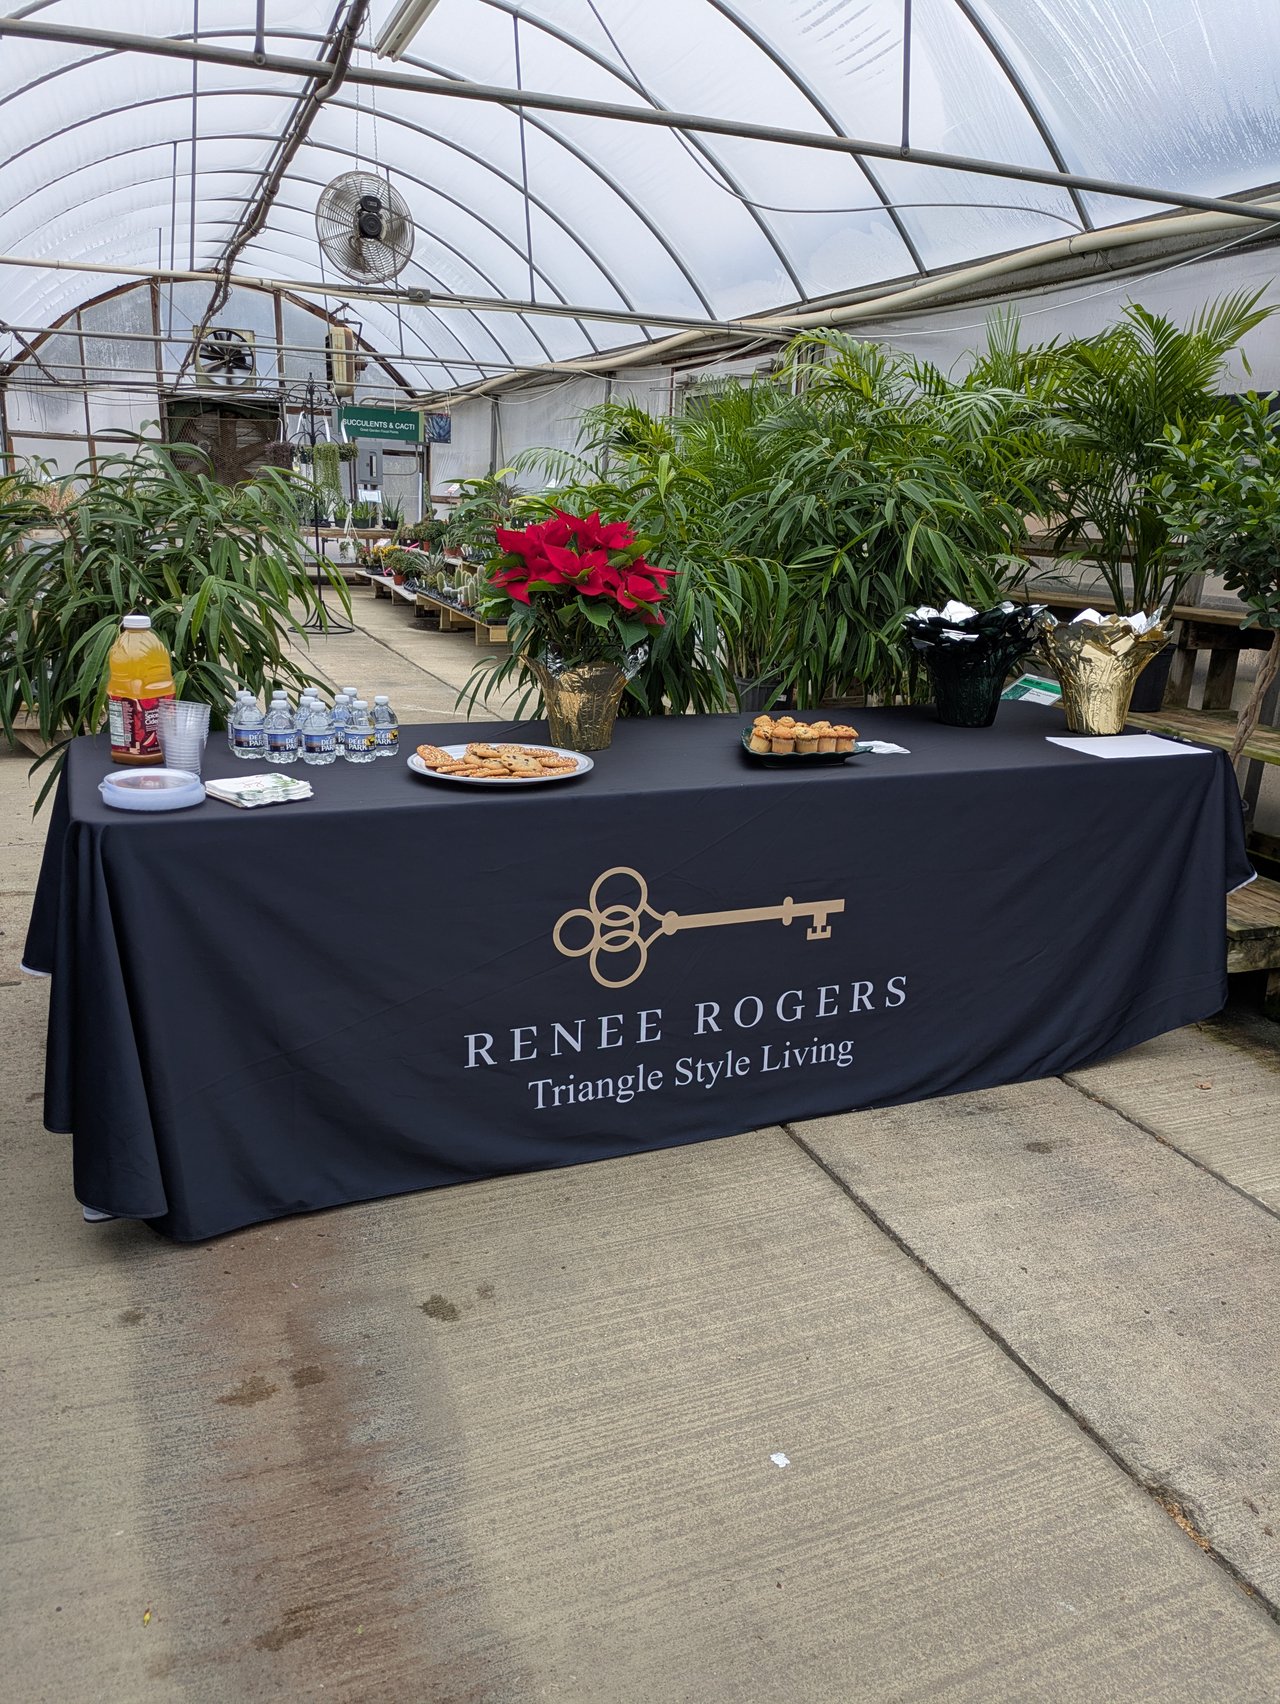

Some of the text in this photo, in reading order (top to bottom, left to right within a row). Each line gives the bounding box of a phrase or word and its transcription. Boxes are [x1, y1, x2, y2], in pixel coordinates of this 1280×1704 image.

[342, 418, 388, 429] SUCCULENTS
[395, 422, 415, 430] CACTI
[348, 737, 367, 745] DEER
[463, 976, 908, 1069] RENEE ROGERS
[528, 1038, 855, 1110] Triangle Style Living
